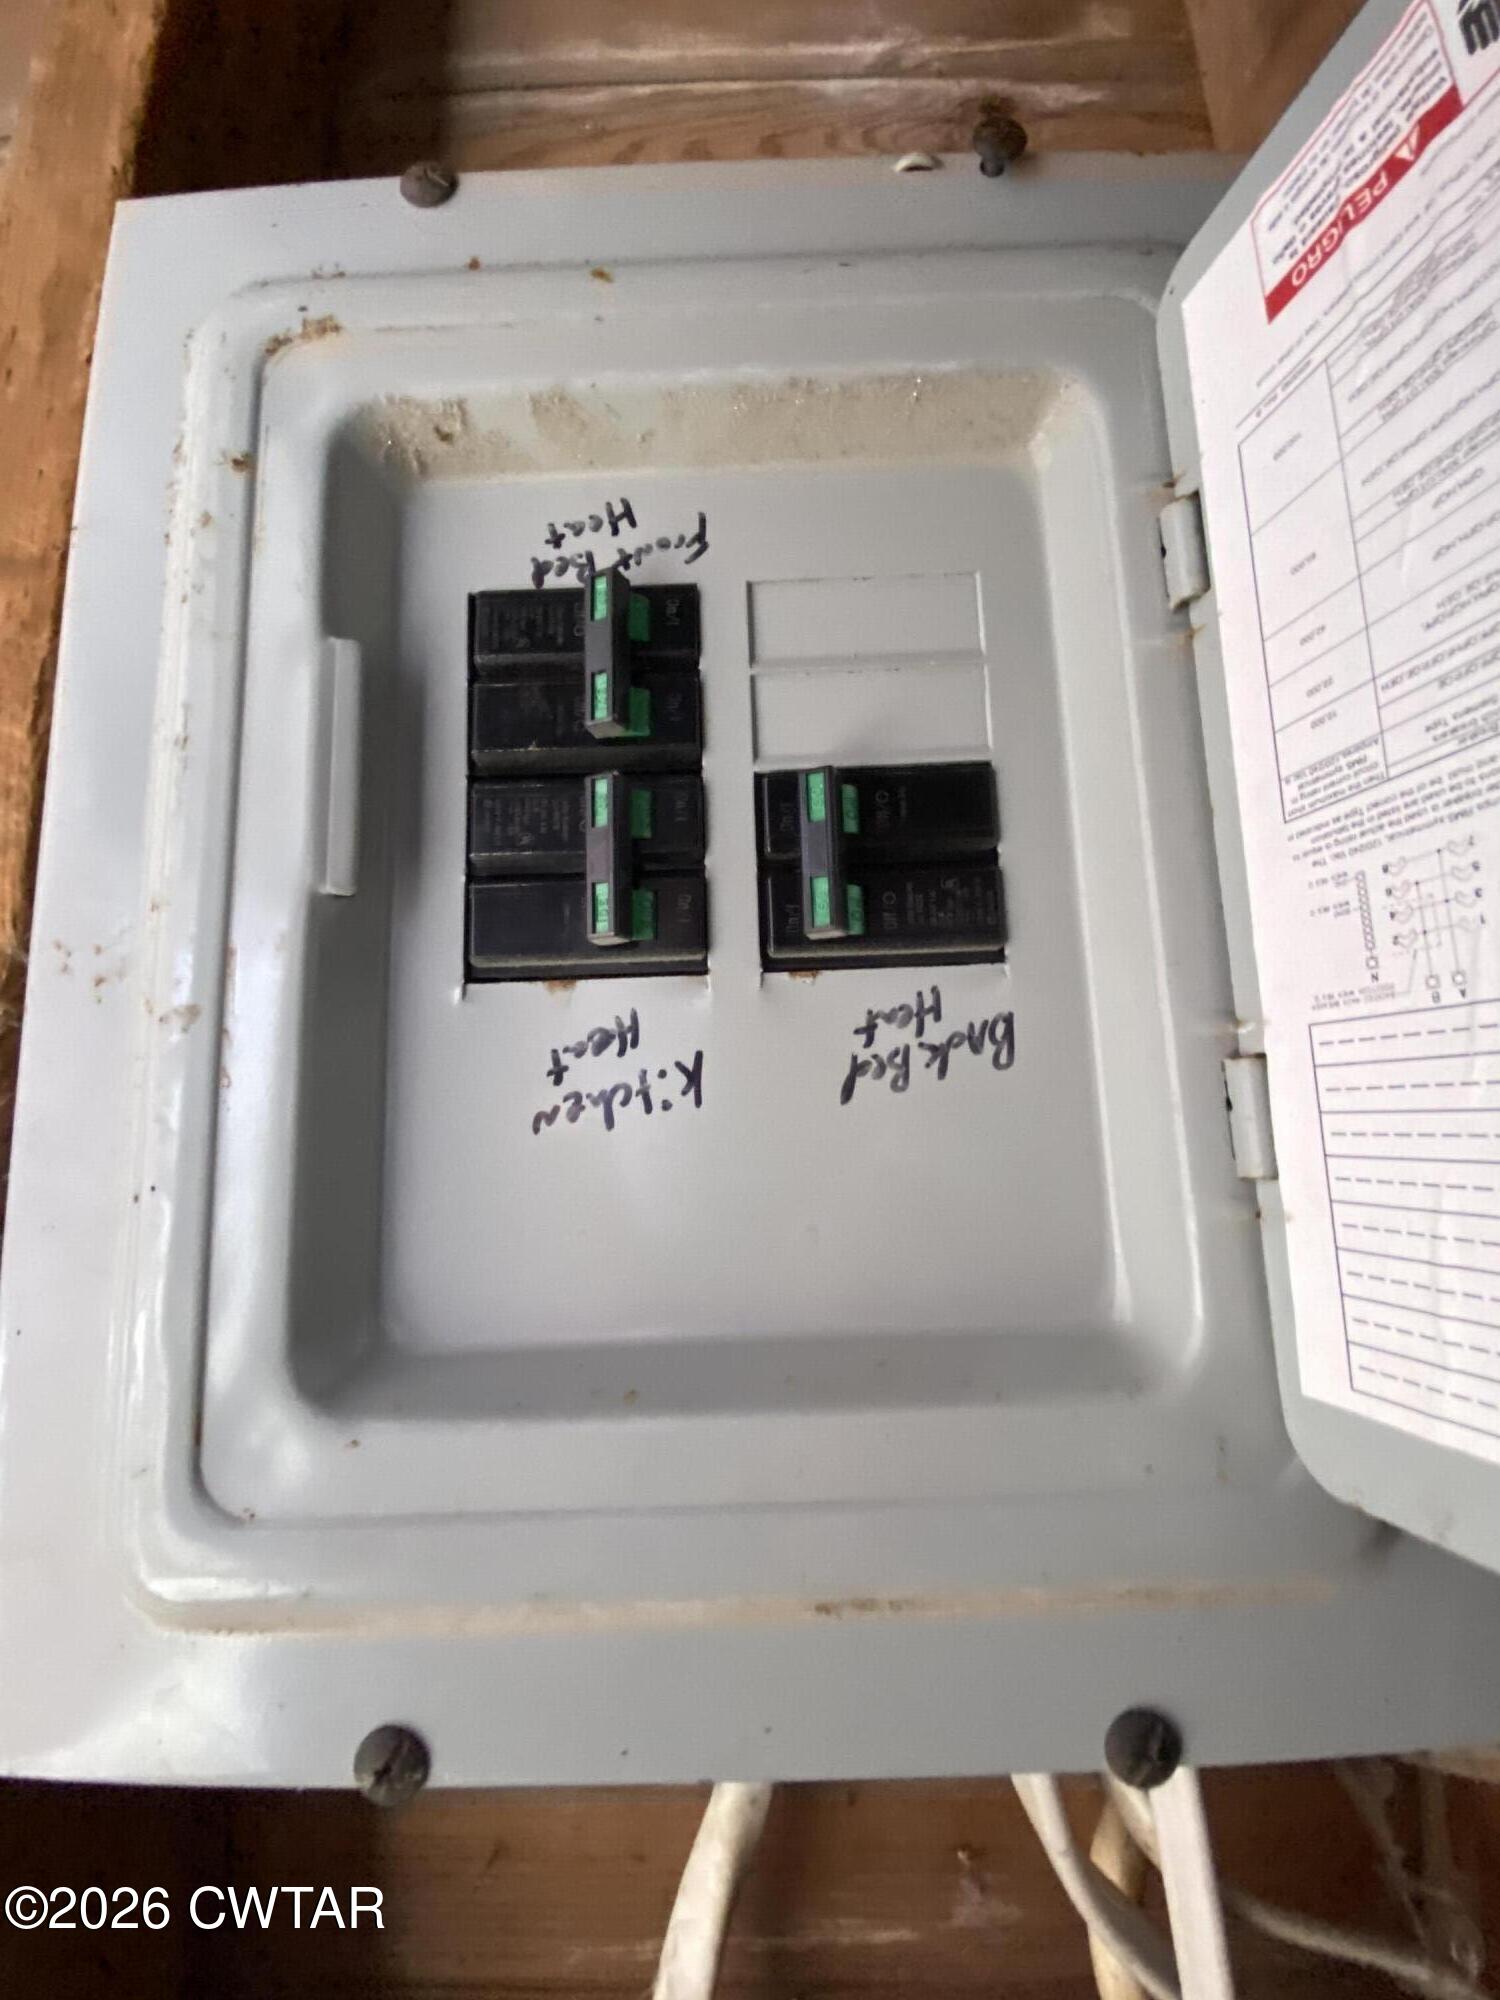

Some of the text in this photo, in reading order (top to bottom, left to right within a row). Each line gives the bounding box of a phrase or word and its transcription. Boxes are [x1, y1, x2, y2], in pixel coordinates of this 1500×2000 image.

[1291, 170, 1389, 287] PELIGRO
[531, 512, 709, 589] Front Bed
[544, 498, 637, 549] Heat
[546, 1008, 640, 1086] Heat
[854, 986, 942, 1047] Heat
[533, 1050, 703, 1134] Kitchen
[840, 1043, 910, 1104] Bed
